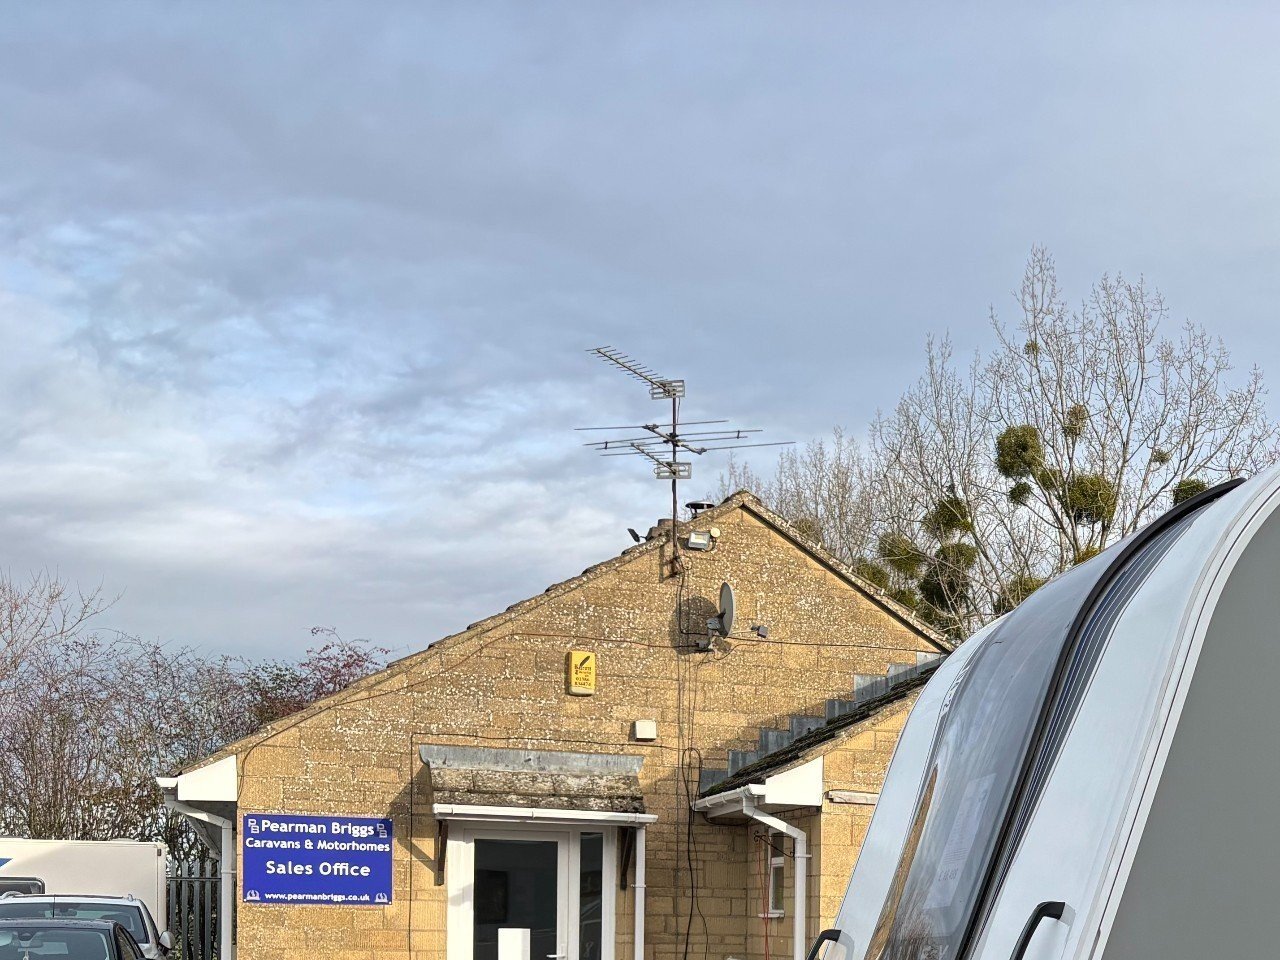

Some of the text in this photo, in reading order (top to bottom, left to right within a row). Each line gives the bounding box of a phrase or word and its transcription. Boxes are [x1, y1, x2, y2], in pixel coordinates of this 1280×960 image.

[261, 819, 375, 838] Pearman Briggs
[245, 838, 390, 852] Caravans & Motorhomes
[266, 860, 371, 877] Sales Office
[264, 892, 370, 902] www.pearmanbriggs.co.uk
